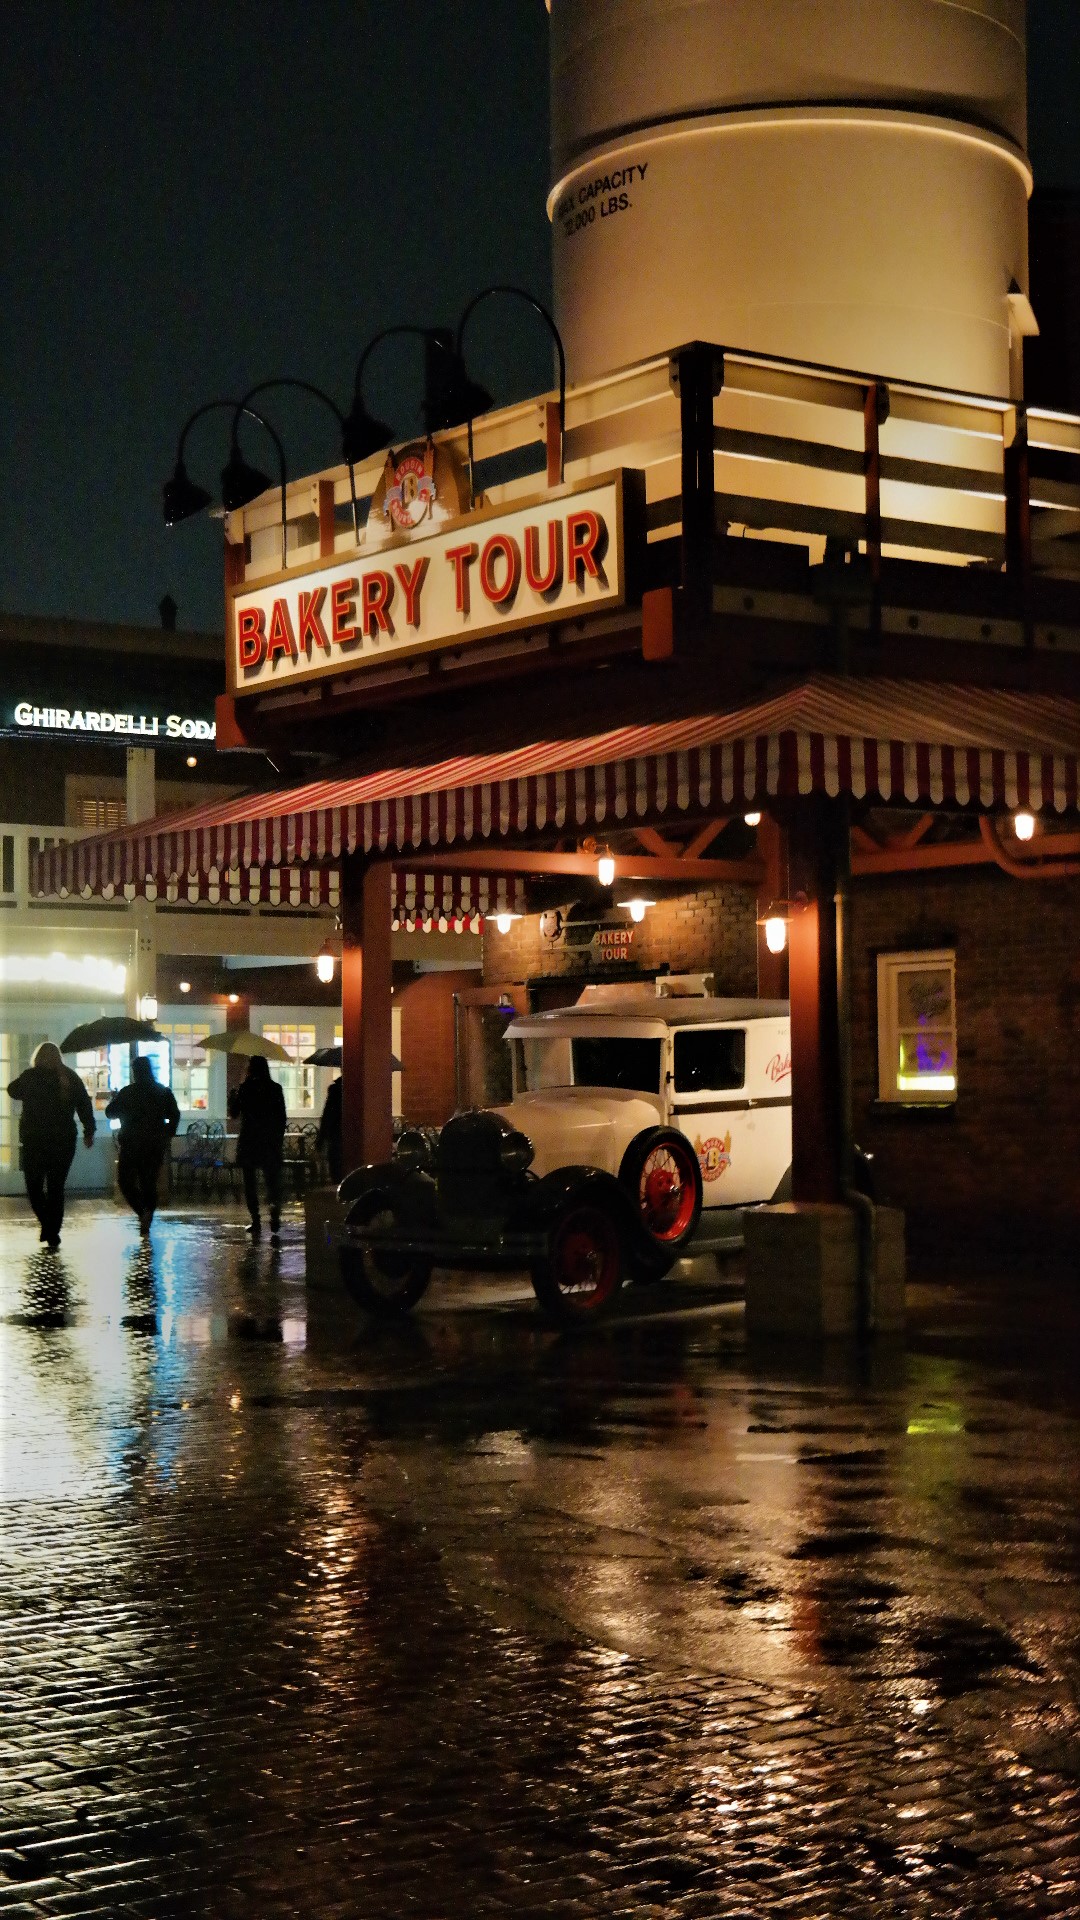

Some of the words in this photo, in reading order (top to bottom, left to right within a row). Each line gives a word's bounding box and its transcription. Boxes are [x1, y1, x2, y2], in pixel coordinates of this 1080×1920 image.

[579, 162, 648, 204] CAPACITY
[601, 193, 632, 217] LBS.
[238, 557, 430, 669] BAKERY
[445, 510, 608, 610] TOUR
[14, 703, 159, 735] GHIRARDELLI
[595, 931, 634, 945] BAKERY
[600, 947, 628, 960] TOUR
